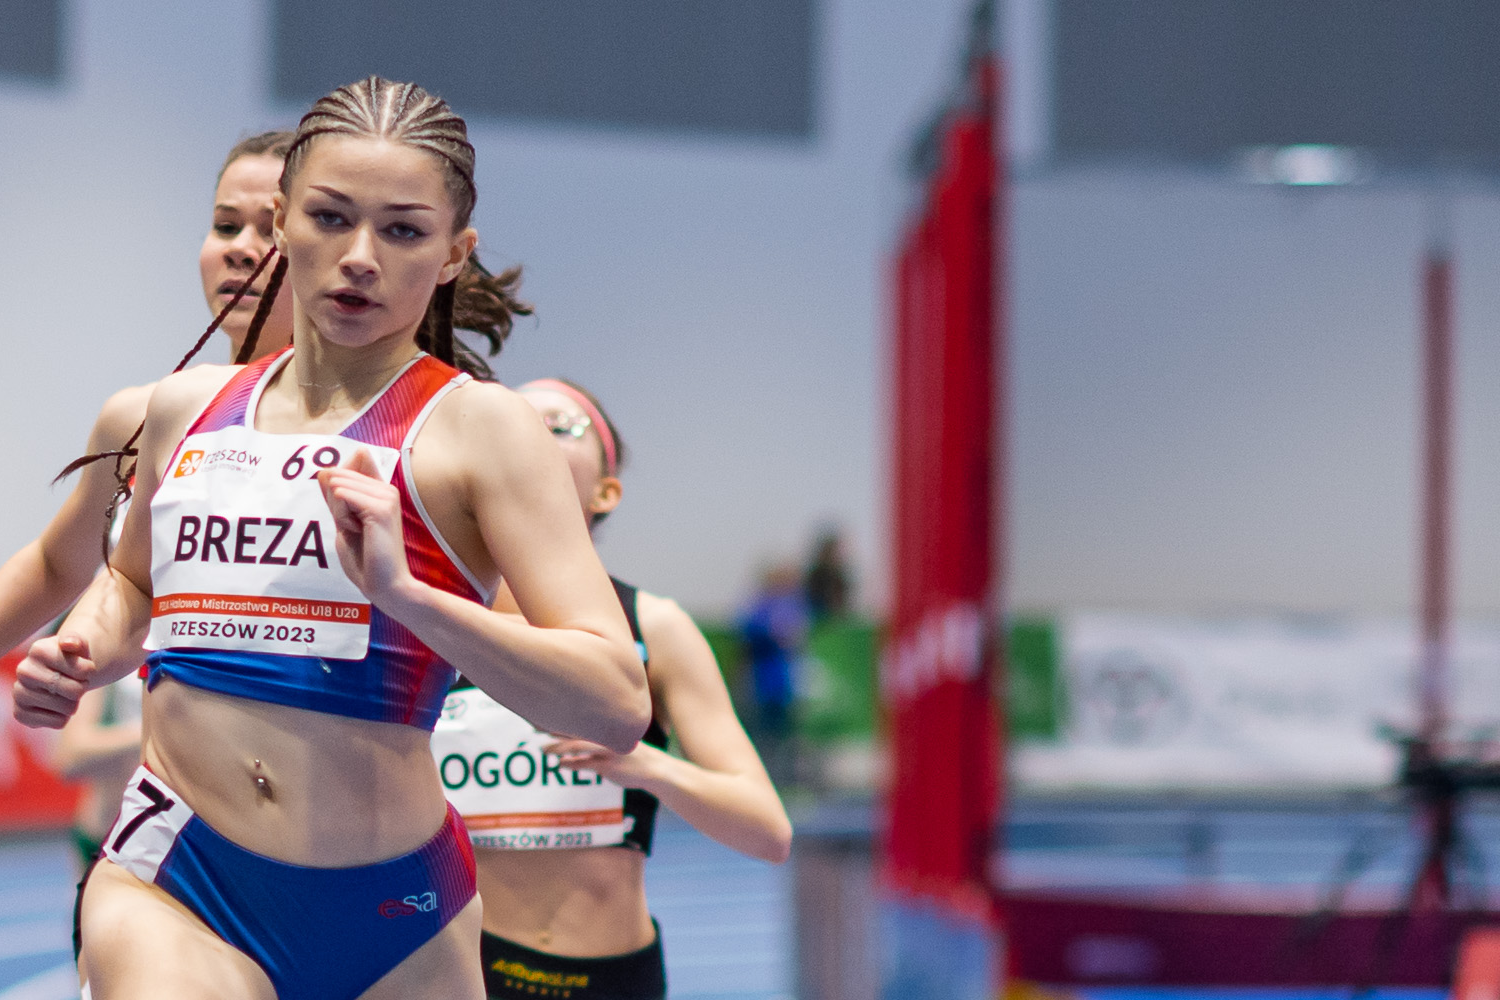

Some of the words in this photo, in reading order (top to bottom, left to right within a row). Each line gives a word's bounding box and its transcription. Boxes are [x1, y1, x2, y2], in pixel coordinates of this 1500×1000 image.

[281, 444, 341, 481] 69
[173, 514, 329, 569] BREZA
[201, 598, 269, 613] Mistrzostwa
[271, 603, 309, 616] Polski
[311, 605, 332, 617] U18
[335, 607, 360, 619] U20
[170, 618, 259, 640] RZESZÓW
[262, 625, 316, 645] 2023
[111, 777, 176, 855] 7
[472, 831, 550, 848] RZESZÓW
[555, 831, 593, 846] 2023
